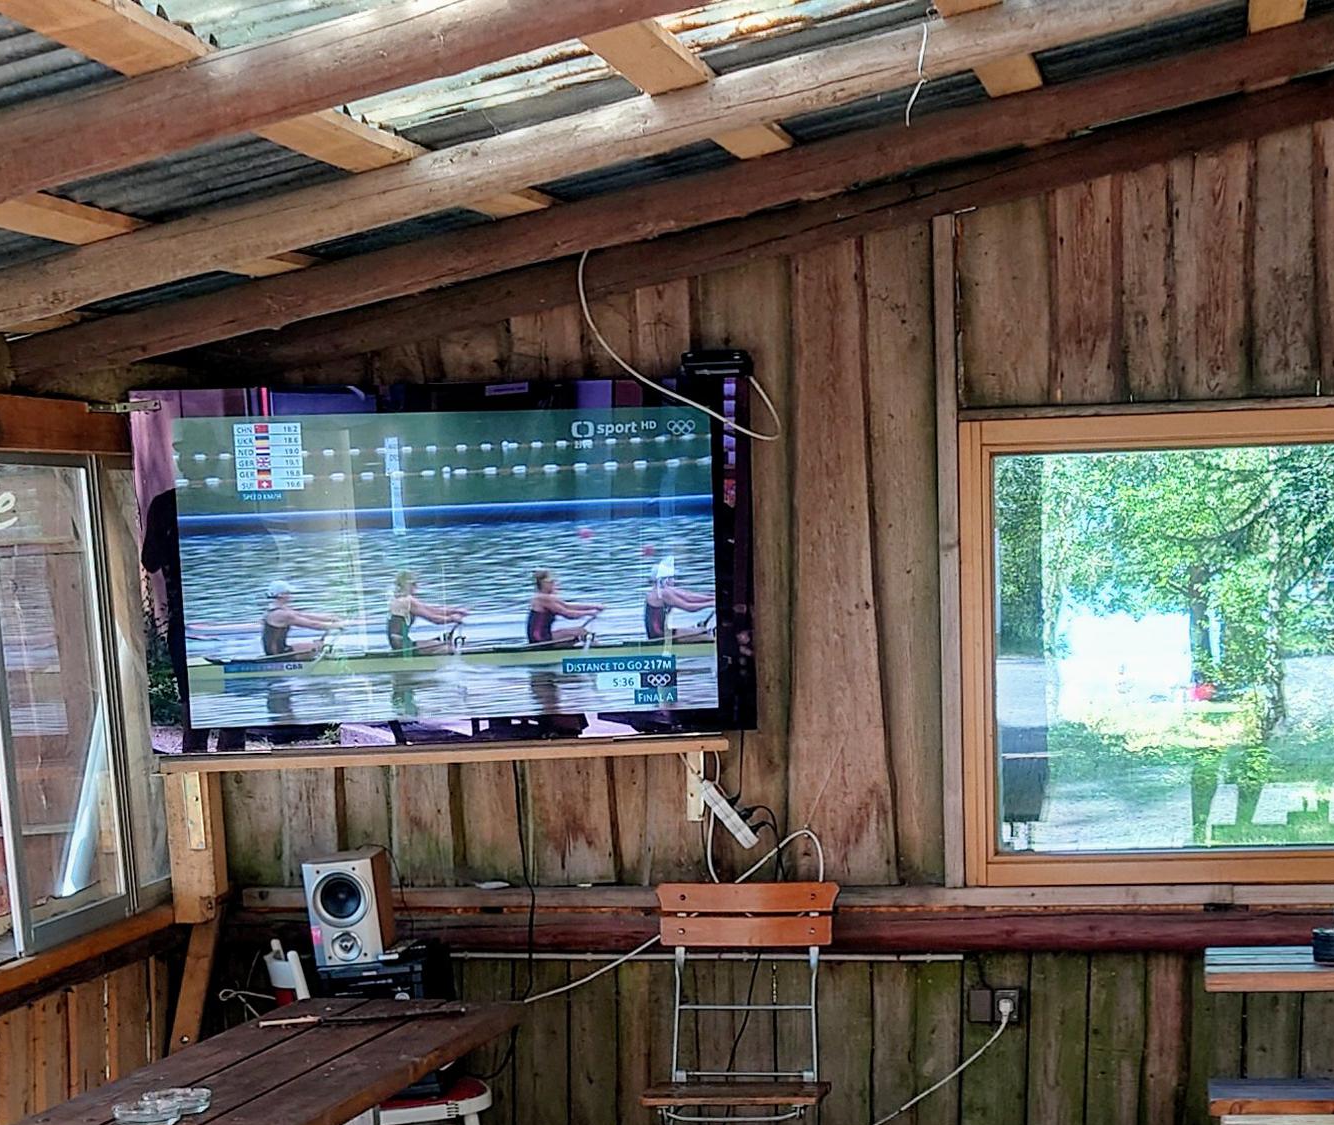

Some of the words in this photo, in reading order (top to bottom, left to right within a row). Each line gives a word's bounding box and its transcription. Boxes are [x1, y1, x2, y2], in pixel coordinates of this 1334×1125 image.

[596, 420, 638, 436] sport
[641, 420, 657, 430] HD
[566, 662, 611, 673] DISTANCE
[613, 662, 626, 671] TO
[627, 660, 643, 670] GO
[643, 659, 673, 670] 217M
[612, 677, 635, 687] 5:36
[637, 692, 664, 703] FINAL
[667, 692, 674, 702] A
